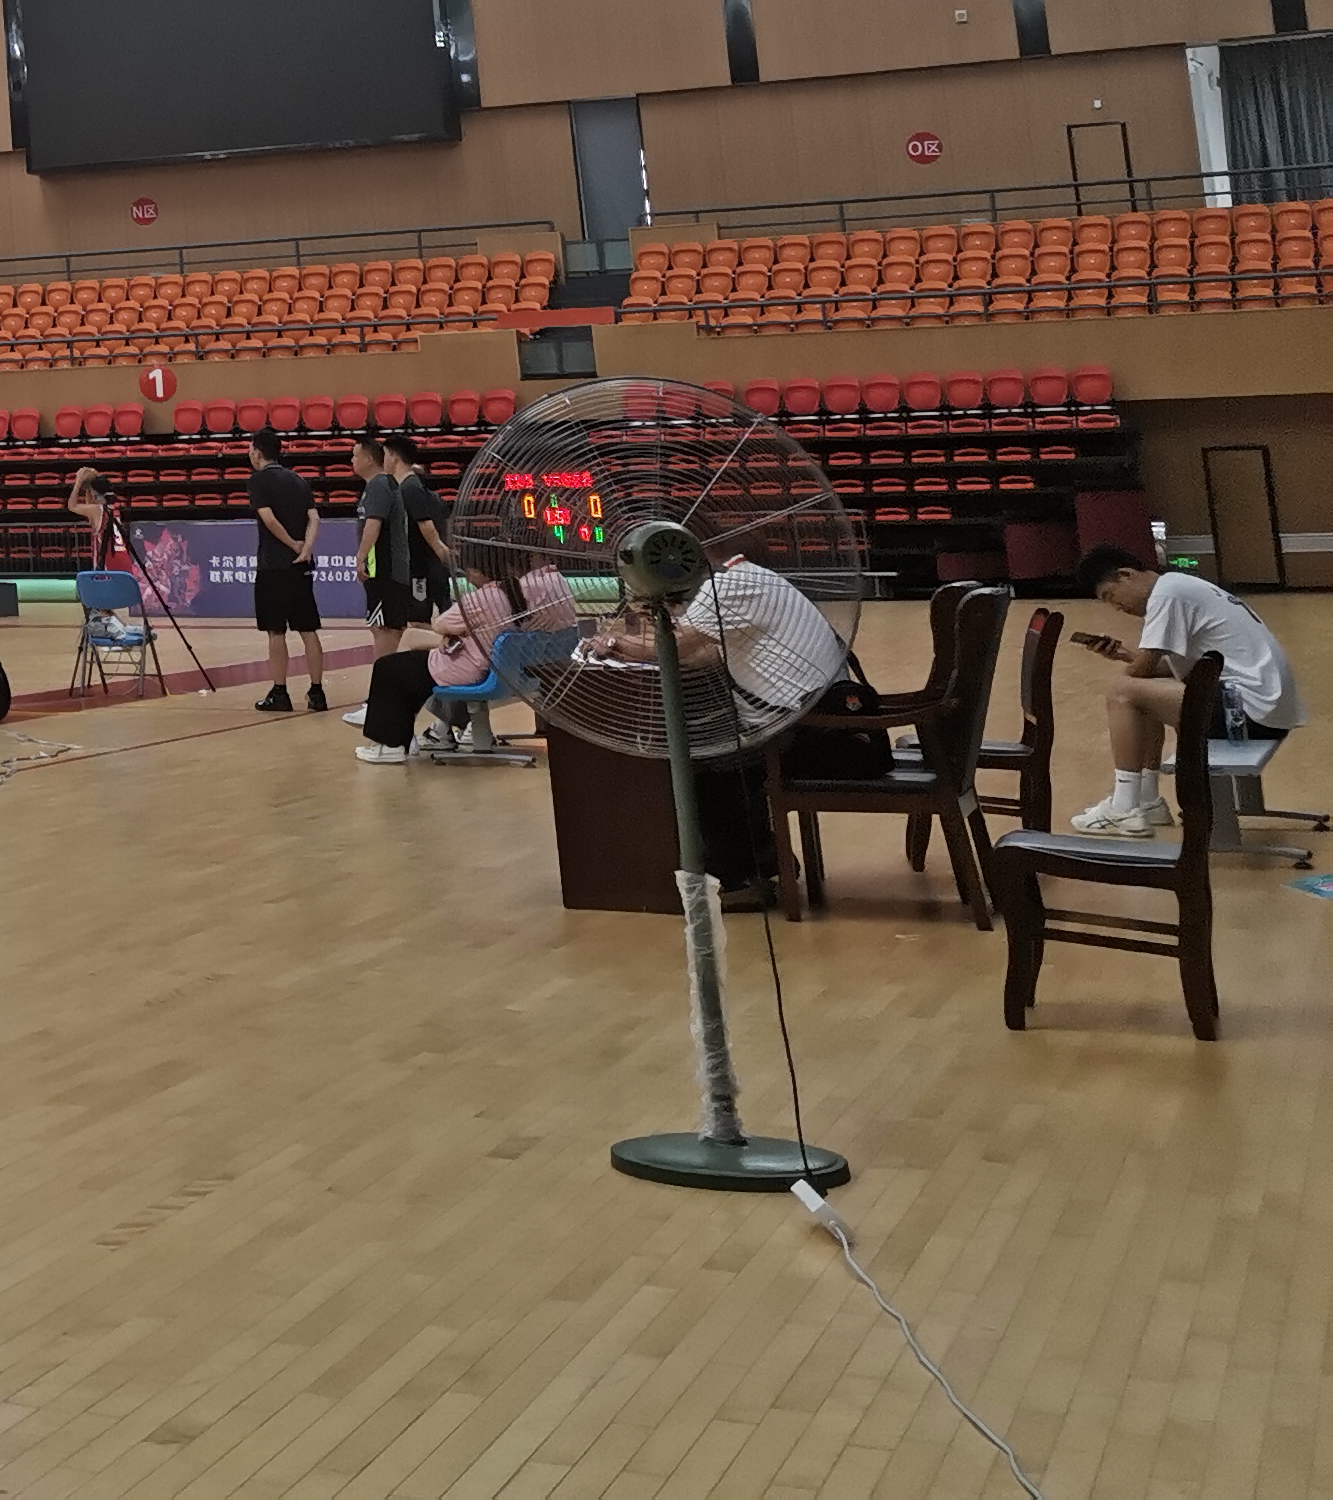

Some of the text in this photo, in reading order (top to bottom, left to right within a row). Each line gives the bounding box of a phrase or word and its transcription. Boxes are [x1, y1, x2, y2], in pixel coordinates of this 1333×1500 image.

[908, 140, 942, 156] O区
[132, 204, 157, 219] N区
[148, 368, 164, 398] 1
